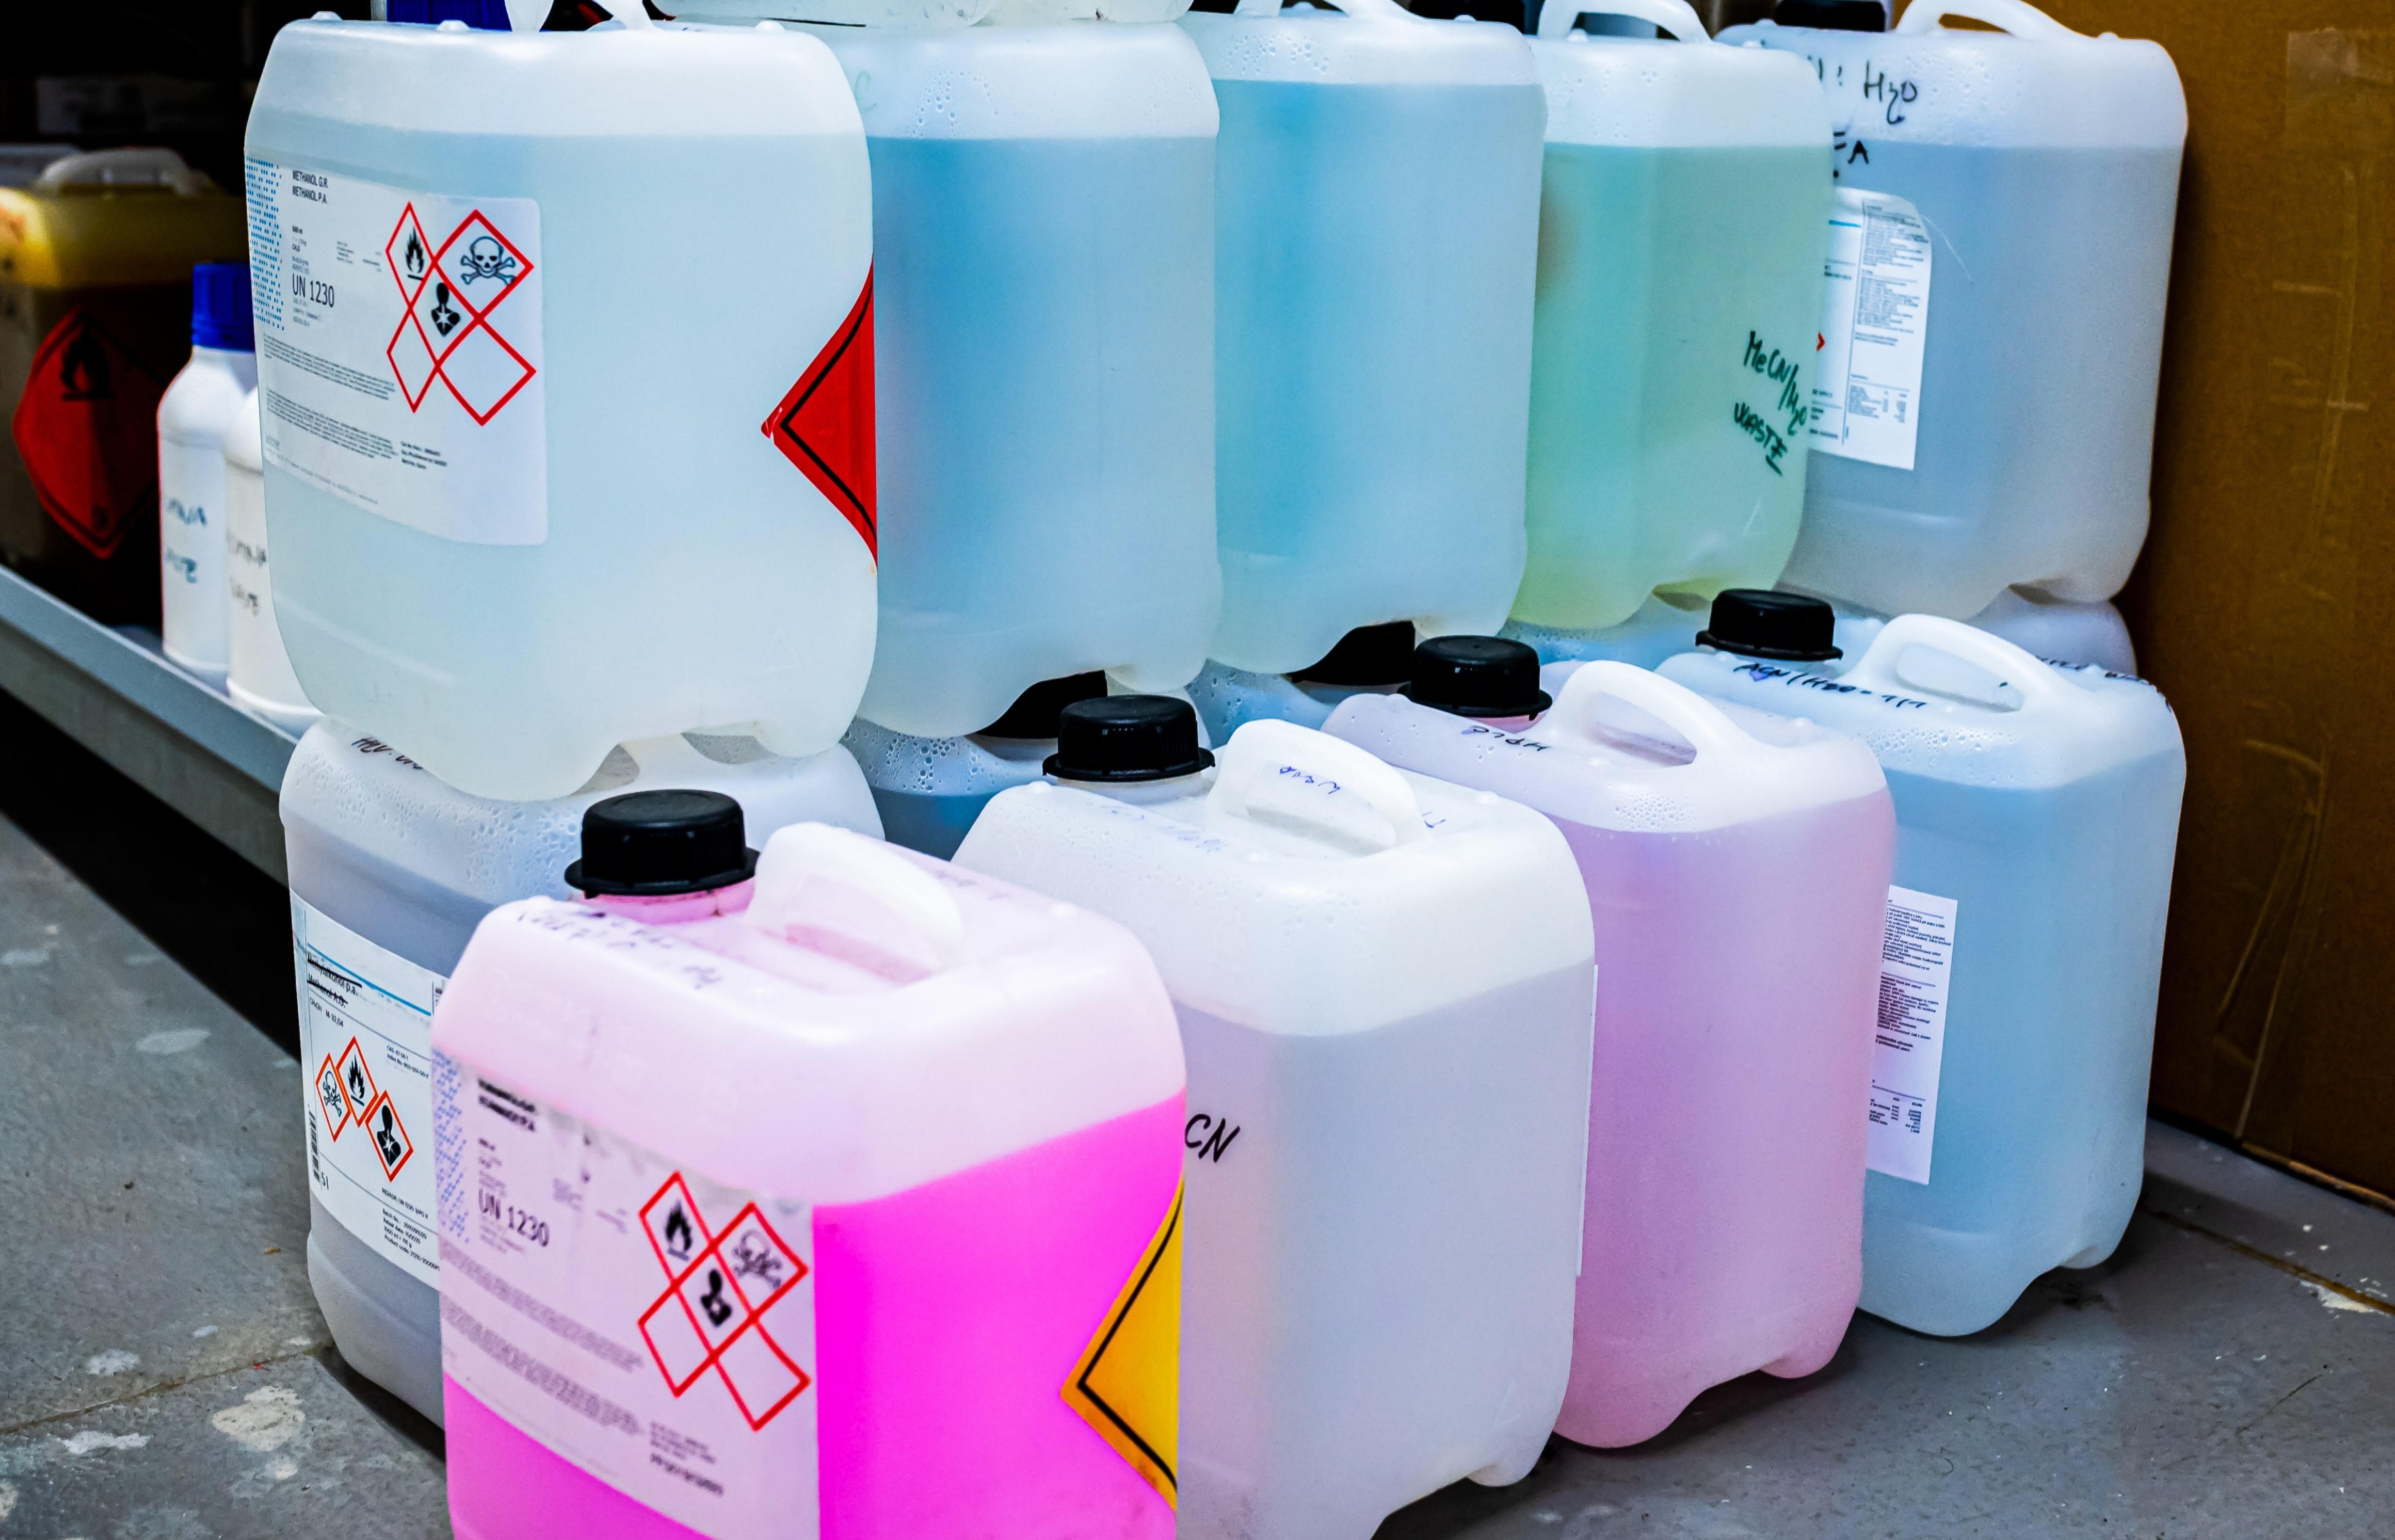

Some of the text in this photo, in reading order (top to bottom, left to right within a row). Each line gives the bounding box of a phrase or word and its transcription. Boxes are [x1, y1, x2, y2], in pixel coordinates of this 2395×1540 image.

[292, 185, 317, 202] METHANOL
[293, 170, 318, 186] METHANOL
[293, 273, 334, 308] UN 1230
[1184, 1113, 1241, 1163] CN
[478, 1189, 550, 1247] UN 1230
